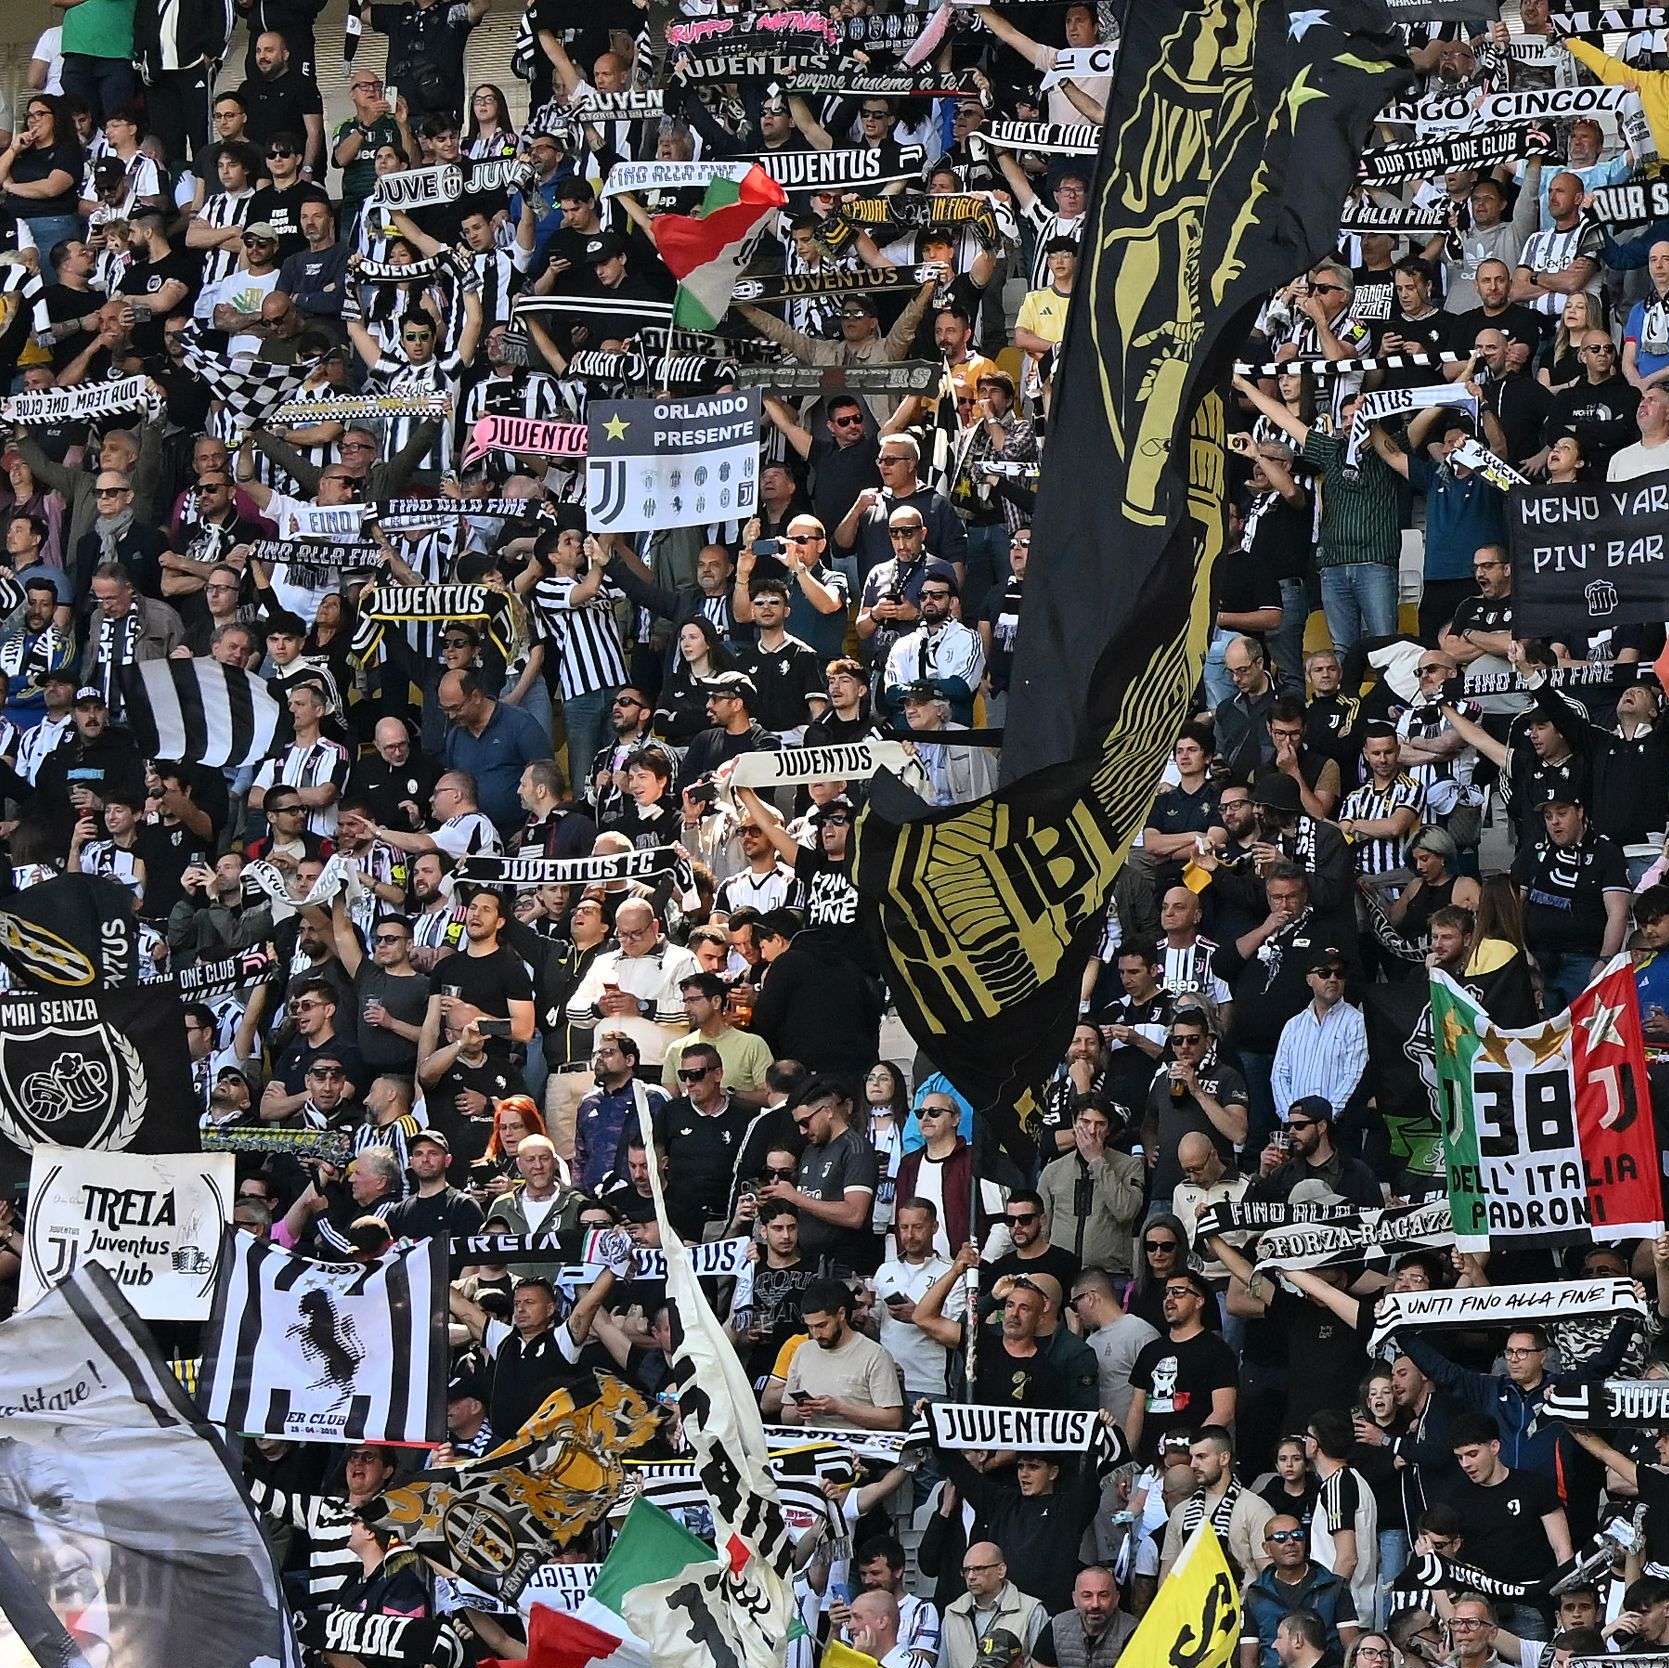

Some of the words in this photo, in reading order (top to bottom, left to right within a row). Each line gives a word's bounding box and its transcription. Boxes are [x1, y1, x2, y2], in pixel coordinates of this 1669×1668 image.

[787, 68, 852, 92] Sempre
[857, 70, 912, 92] insieme
[937, 69, 966, 91] te!
[764, 150, 880, 181] JUVENTUS
[1377, 153, 1405, 172] OUR
[1409, 146, 1453, 168] TEAM,
[1452, 138, 1479, 161] ONE
[1482, 134, 1516, 155] CLUB
[379, 175, 436, 206] JUVE
[1596, 186, 1643, 222] OUR
[852, 201, 888, 222] PADRE
[781, 267, 898, 293] JUVENTUS
[655, 397, 748, 420] ORLANDO
[655, 425, 753, 447] PRESENTE
[390, 502, 432, 519] FINO
[438, 501, 480, 519] ALLA
[489, 500, 529, 518] FINE
[1523, 500, 1598, 524] MENO
[1613, 486, 1669, 517] VAR
[1535, 544, 1594, 574] PIU'
[1608, 534, 1664, 567] BAR
[372, 586, 485, 615] JUVENTUS
[775, 745, 871, 778] JUVENTUS
[499, 857, 618, 882] JUVENTUS
[626, 850, 654, 874] FC
[181, 967, 204, 987] ONE
[208, 960, 236, 983] CLUB
[3, 1004, 35, 1026] MAI
[41, 998, 98, 1024] SENZA
[84, 1187, 176, 1229] TREIA
[1232, 1205, 1284, 1225] FINO
[1472, 1197, 1607, 1233] PADRONI
[88, 1231, 171, 1260] Juventus
[450, 1235, 562, 1254] TREIA
[1275, 1229, 1354, 1258] FORZA
[1407, 1298, 1454, 1315] UNITI
[1461, 1295, 1502, 1312] FINO
[1507, 1291, 1556, 1309] ALLA
[1559, 1287, 1605, 1305] FINE
[944, 1408, 1090, 1443] JUVENTUS
[325, 1611, 405, 1659] YILDIZ
